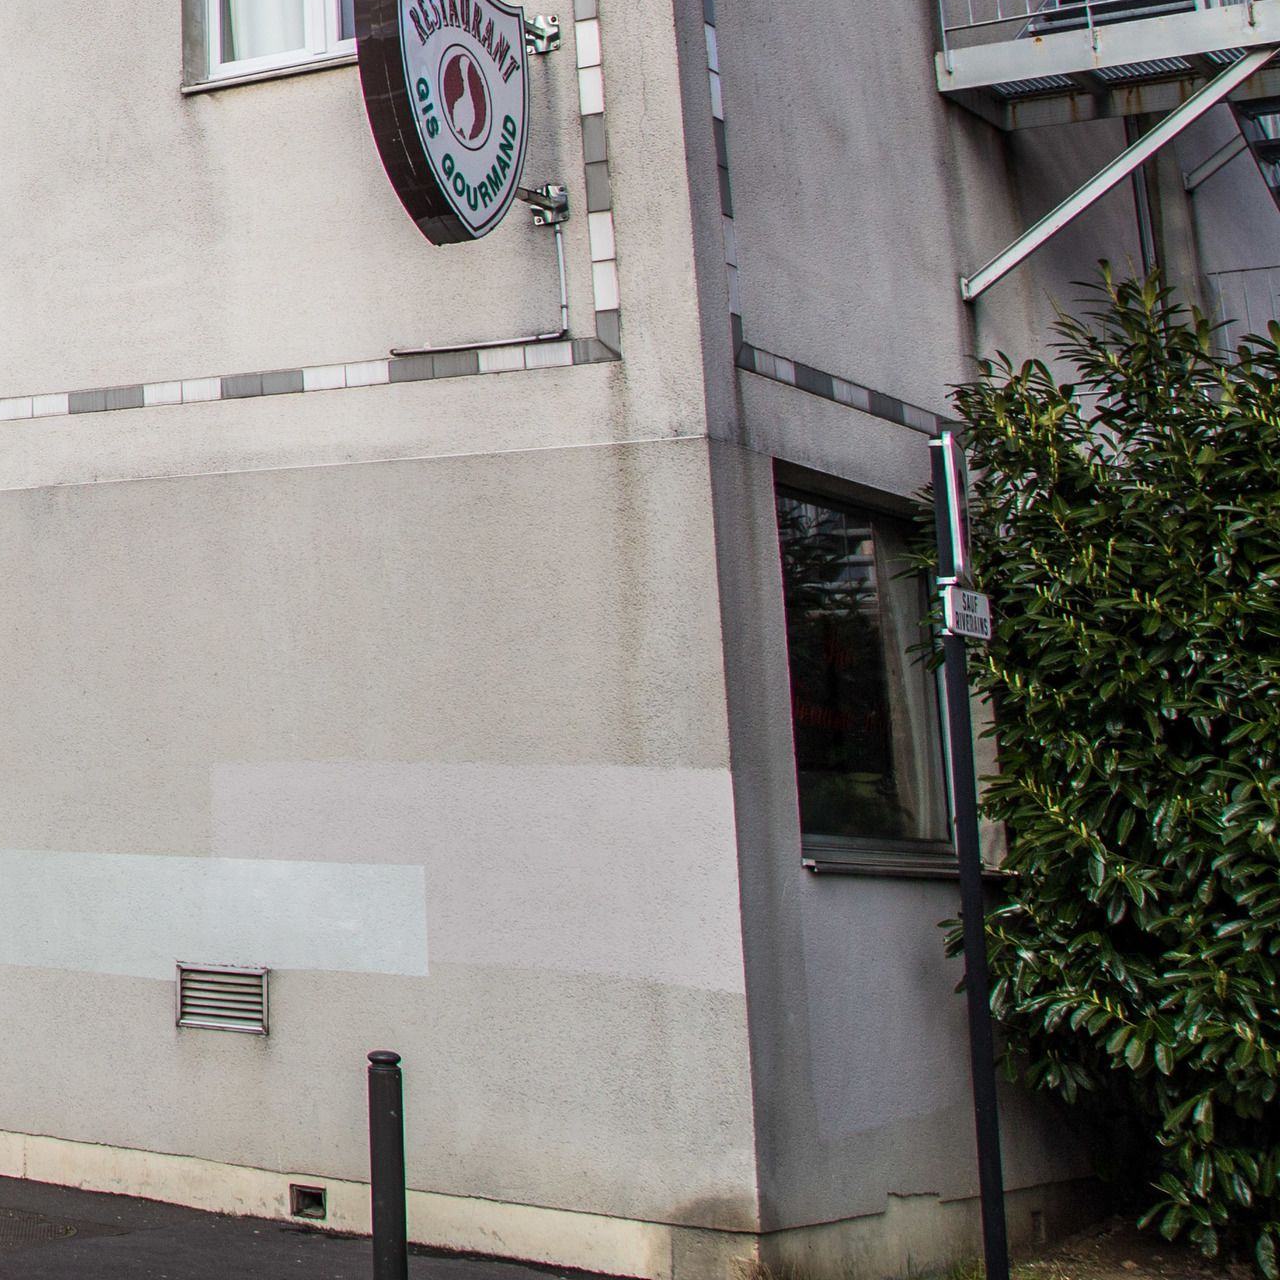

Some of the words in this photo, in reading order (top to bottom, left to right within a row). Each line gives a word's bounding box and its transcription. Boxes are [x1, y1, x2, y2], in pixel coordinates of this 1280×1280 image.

[440, 113, 517, 212] GOURMAND
[962, 592, 977, 613] SAUF
[955, 611, 988, 636] RIVERAINS
